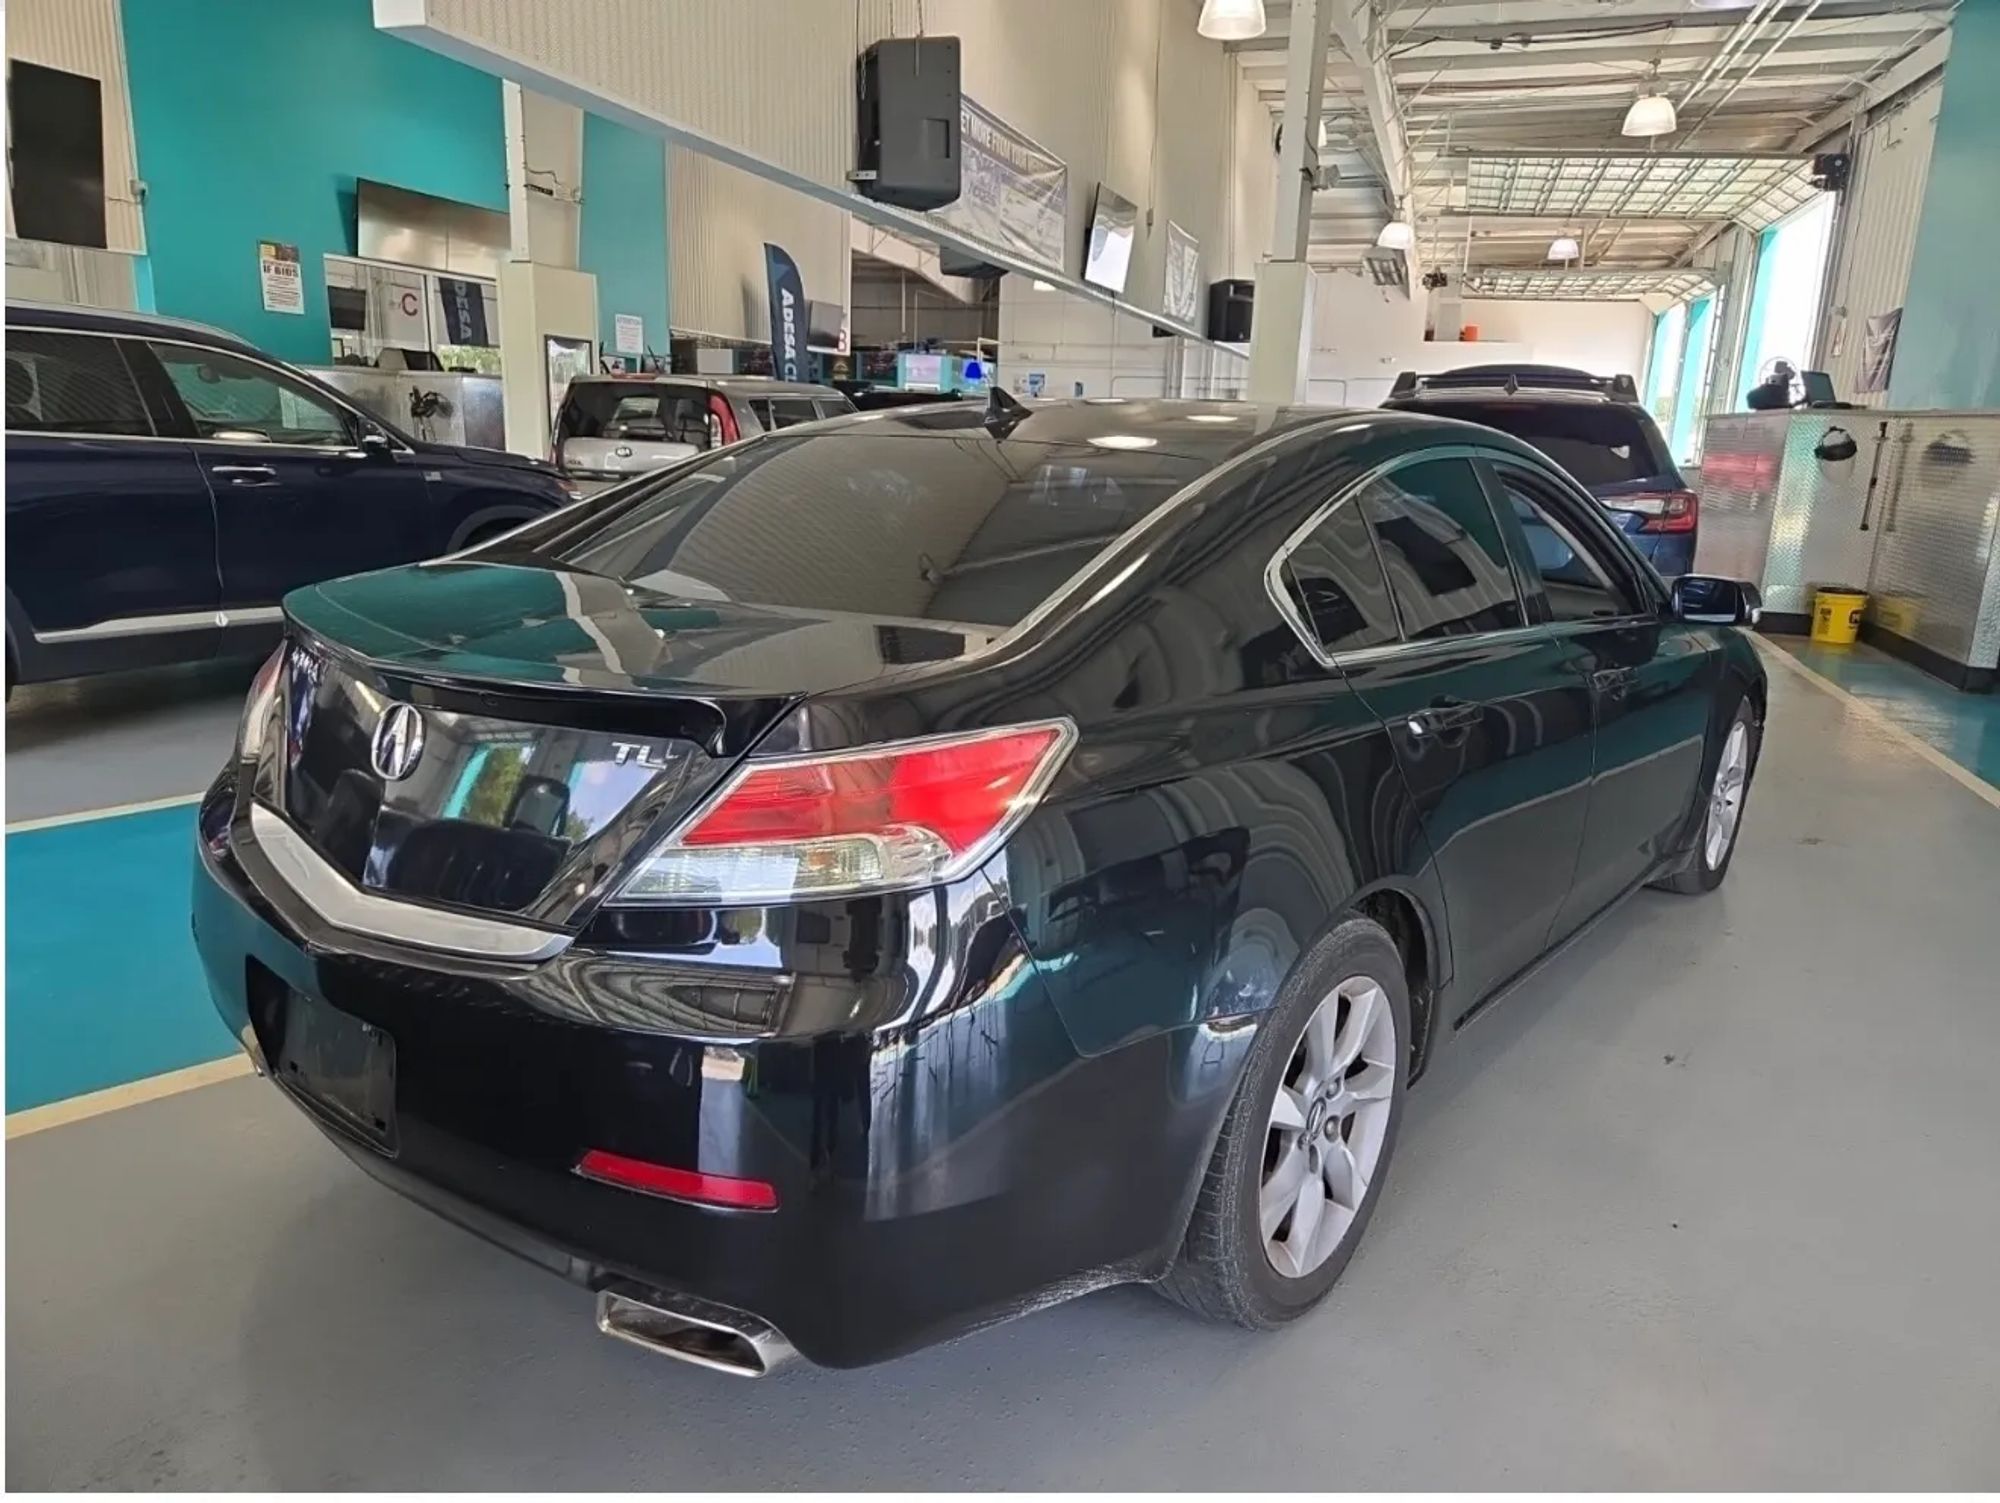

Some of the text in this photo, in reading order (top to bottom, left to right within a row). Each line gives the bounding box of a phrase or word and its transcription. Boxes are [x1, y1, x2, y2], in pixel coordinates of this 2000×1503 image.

[402, 292, 418, 316] C
[455, 281, 472, 340] DESA
[781, 287, 797, 360] ADESA
[611, 741, 667, 770] TL
